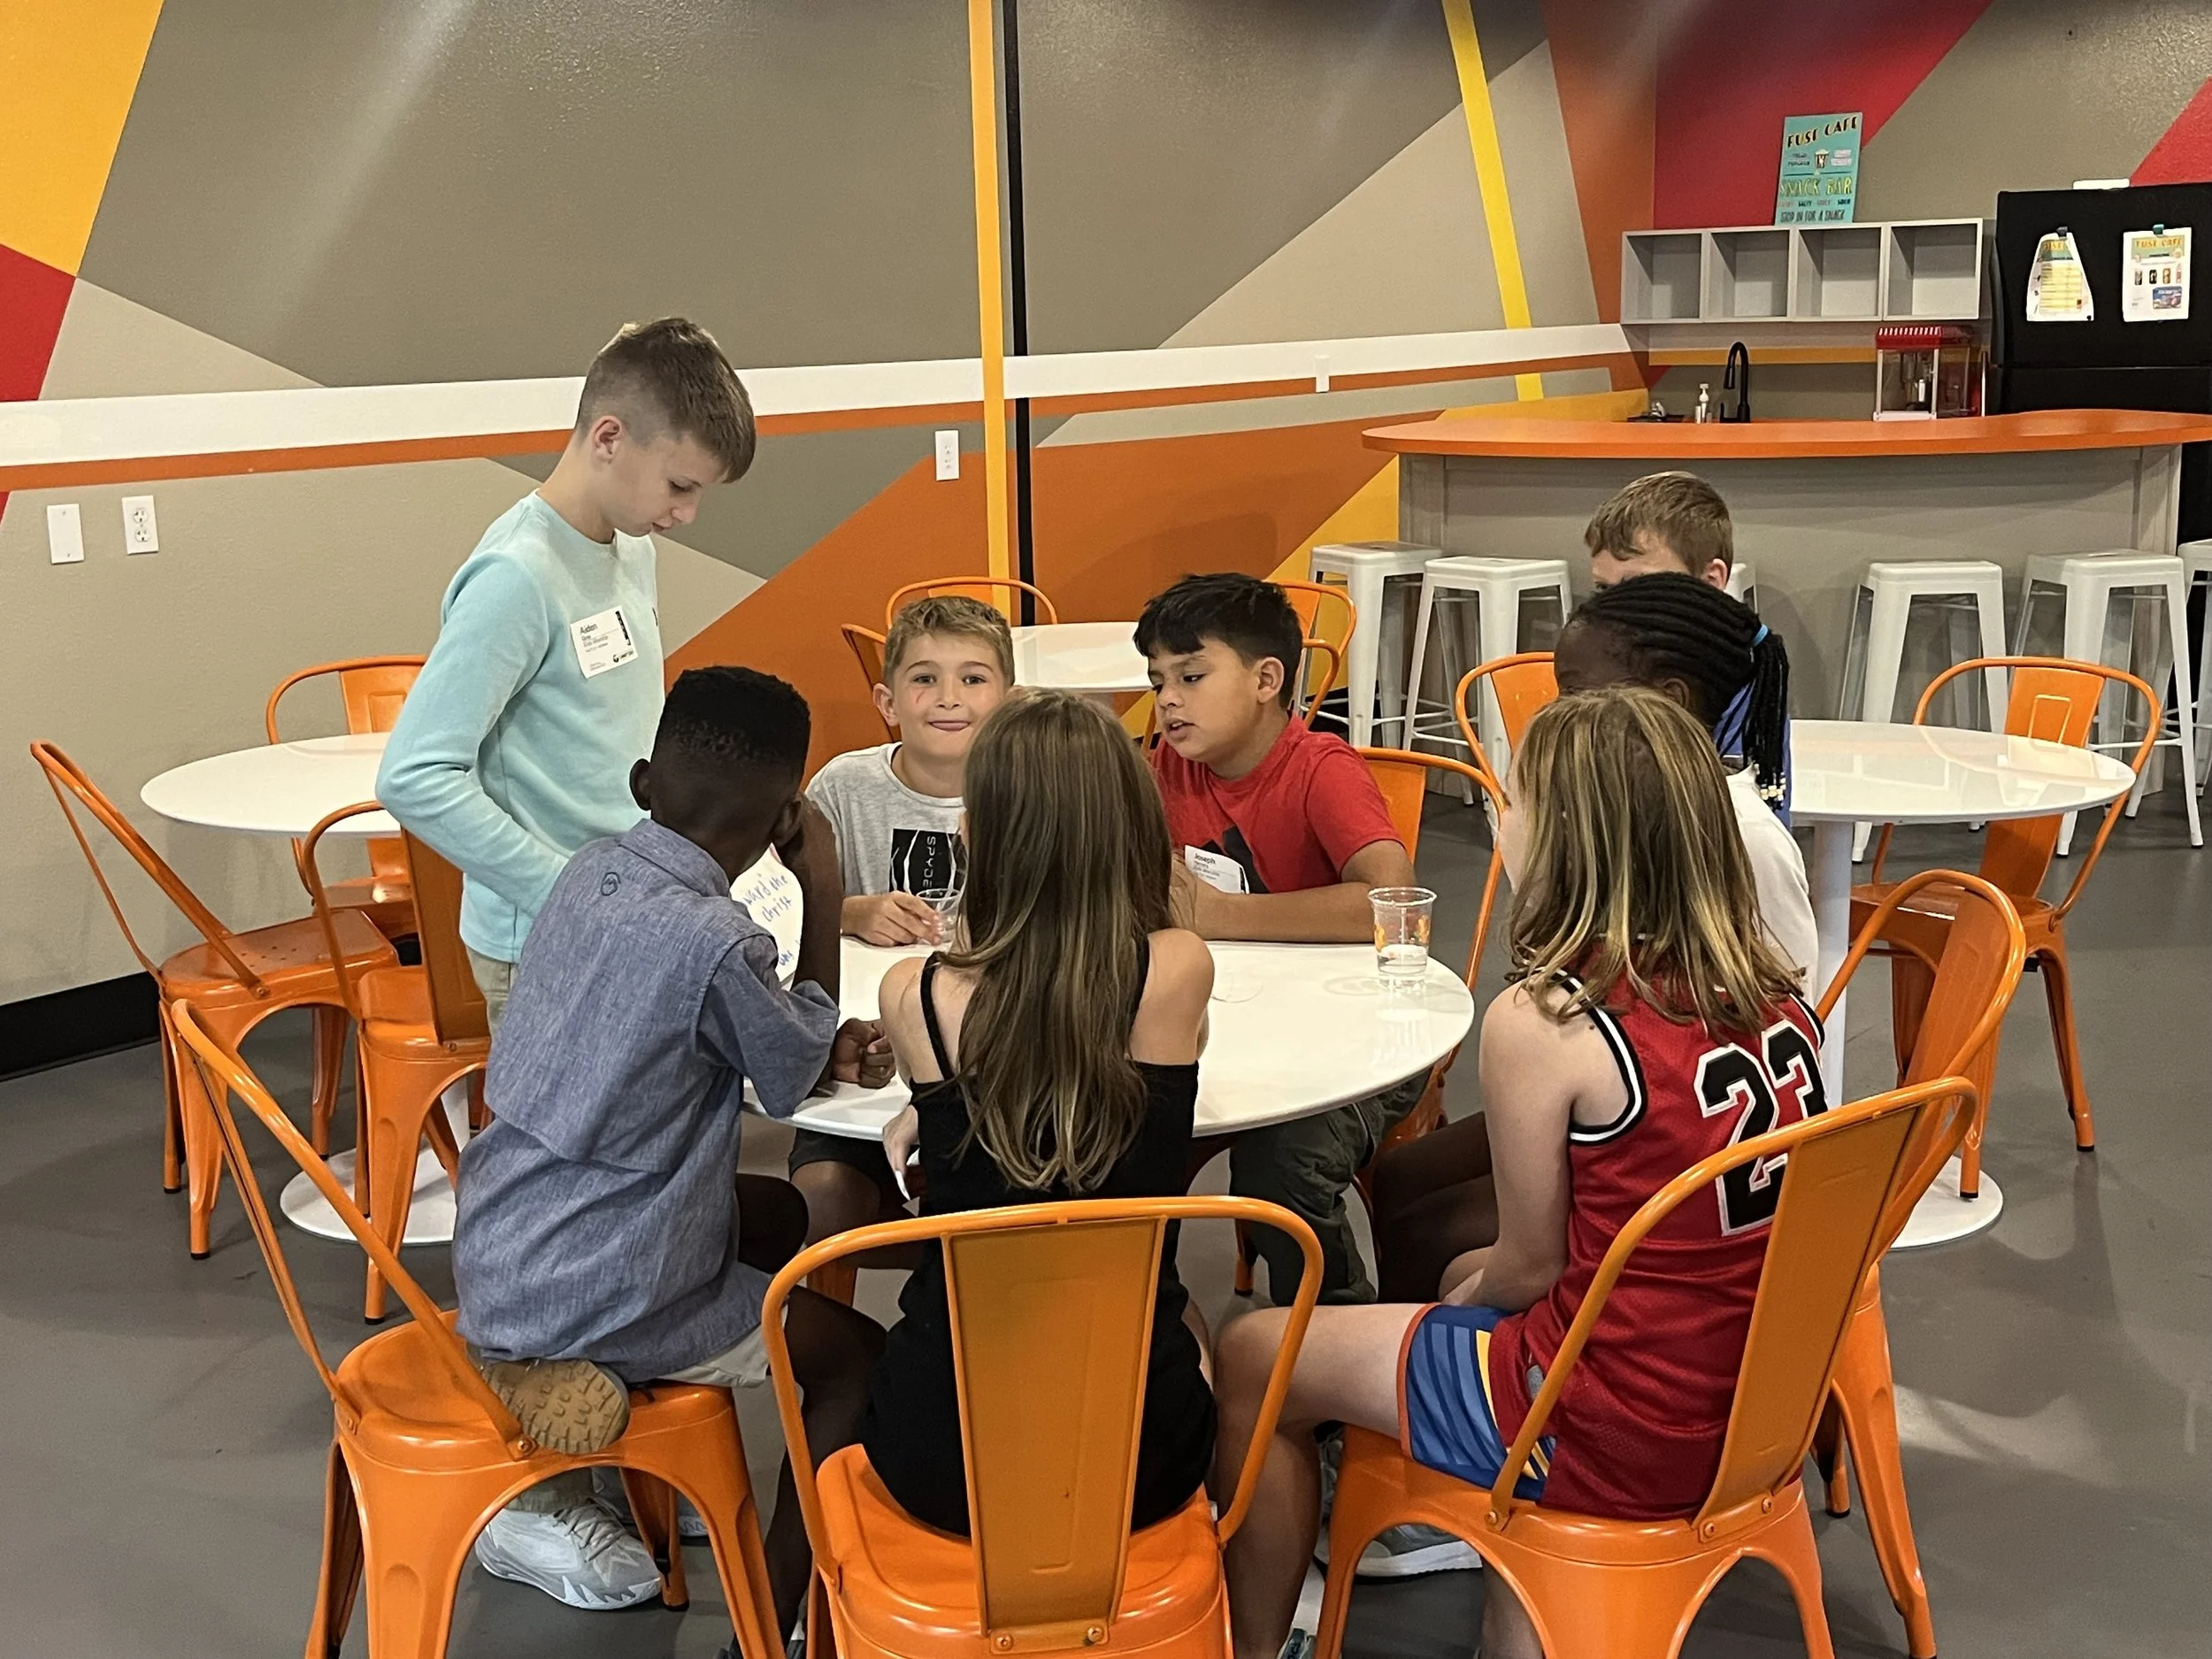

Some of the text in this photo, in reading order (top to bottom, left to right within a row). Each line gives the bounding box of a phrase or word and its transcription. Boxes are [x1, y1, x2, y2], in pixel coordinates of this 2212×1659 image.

[1787, 116, 1857, 149] FUSE CAFE
[1826, 177, 1853, 195] BAR
[922, 835, 936, 888] SPYDE
